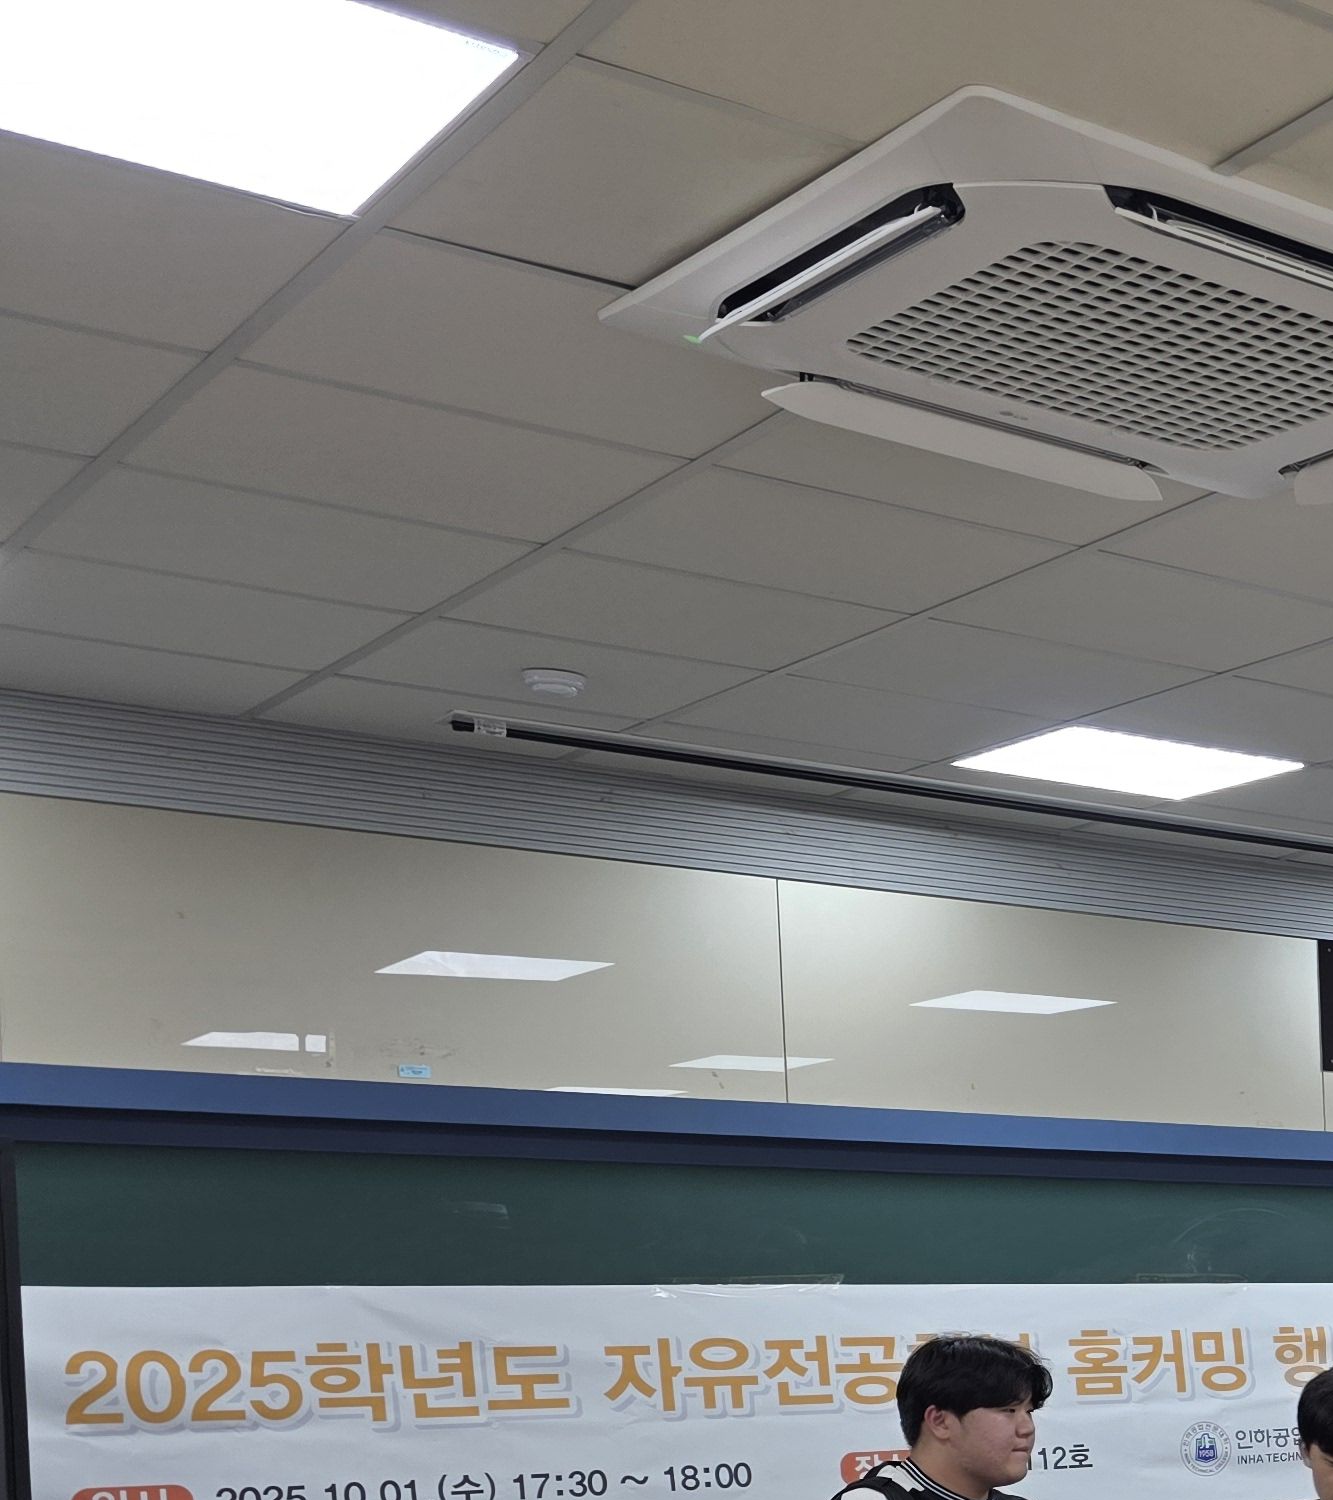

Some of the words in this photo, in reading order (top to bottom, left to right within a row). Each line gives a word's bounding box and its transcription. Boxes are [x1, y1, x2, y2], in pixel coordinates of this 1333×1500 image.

[64, 1340, 571, 1426] 2025학년도
[603, 1332, 1030, 1412] 자유전공
[1067, 1327, 1247, 1396] 홈커밍
[1237, 1454, 1264, 1464] INHA
[512, 1469, 608, 1500] 17:30
[663, 1462, 753, 1492] 18:00
